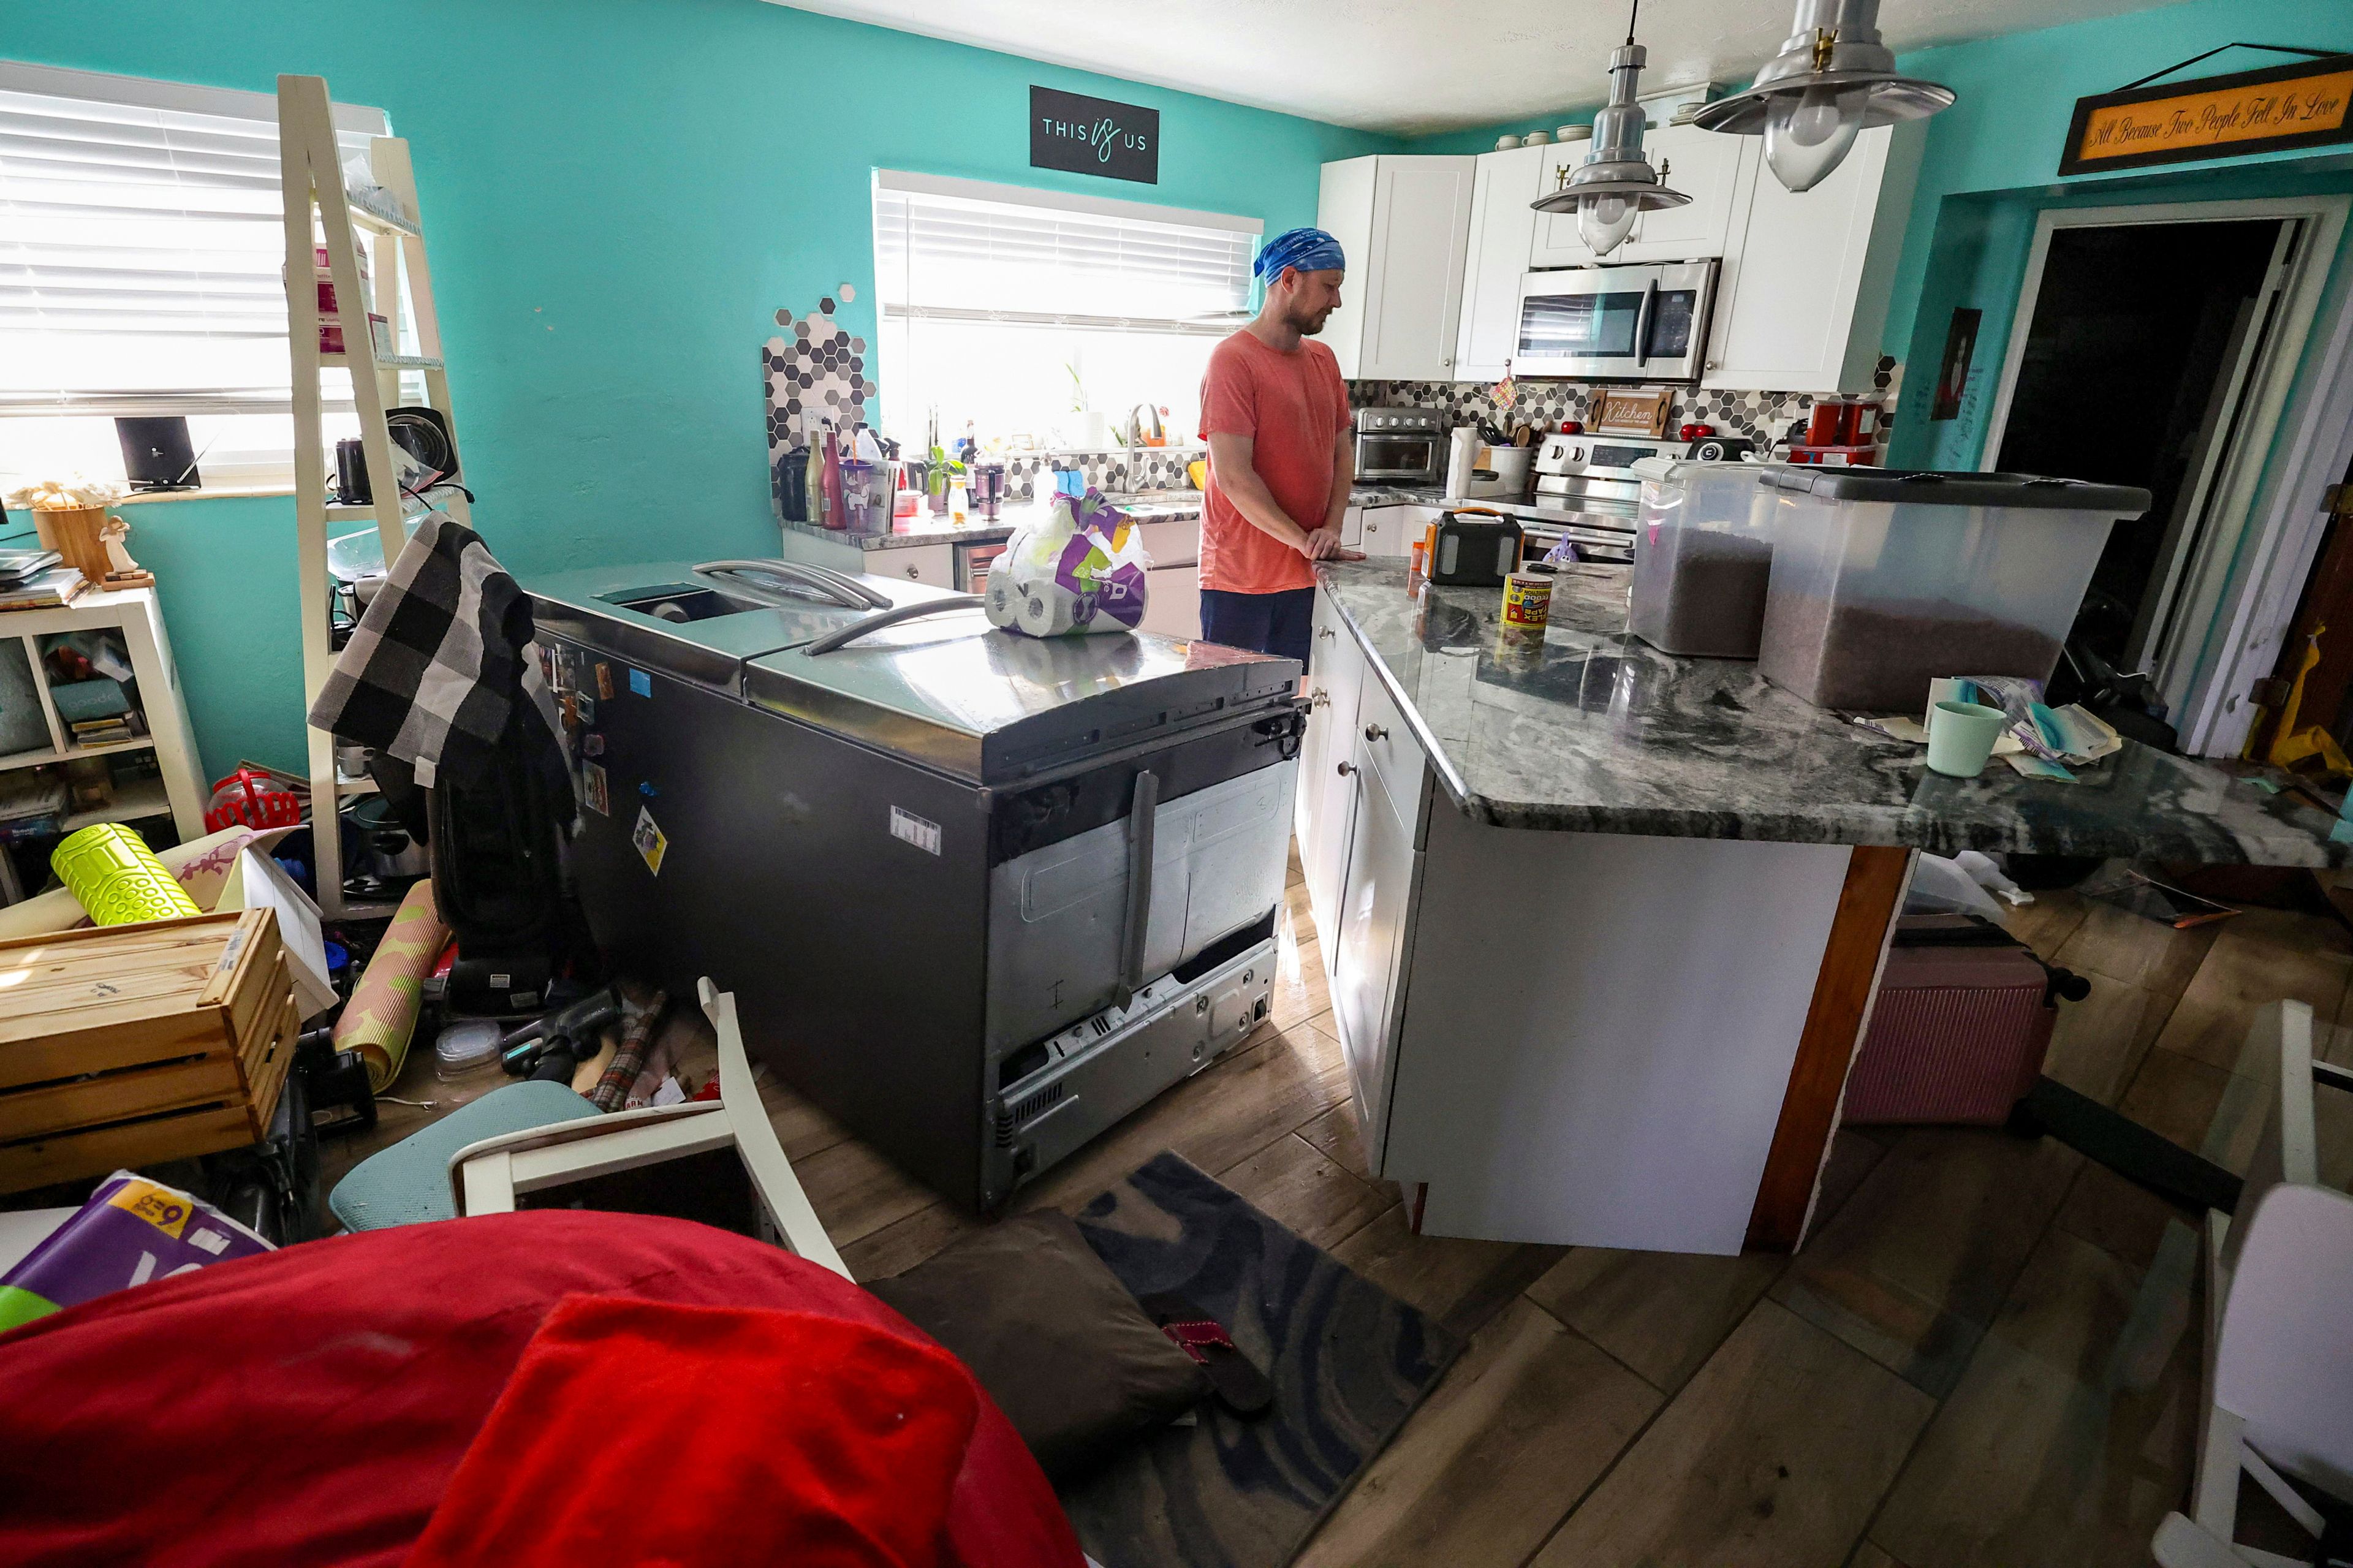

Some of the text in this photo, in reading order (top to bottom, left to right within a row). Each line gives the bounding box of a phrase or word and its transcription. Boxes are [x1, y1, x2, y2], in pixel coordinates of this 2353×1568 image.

[2089, 88, 2339, 147] All Because Two People Fell In Love
[1042, 118, 1146, 162] THIS is US
[1601, 401, 1653, 422] Kitchen
[1523, 612, 1548, 621] FLEX
[1524, 605, 1548, 615] TAPE
